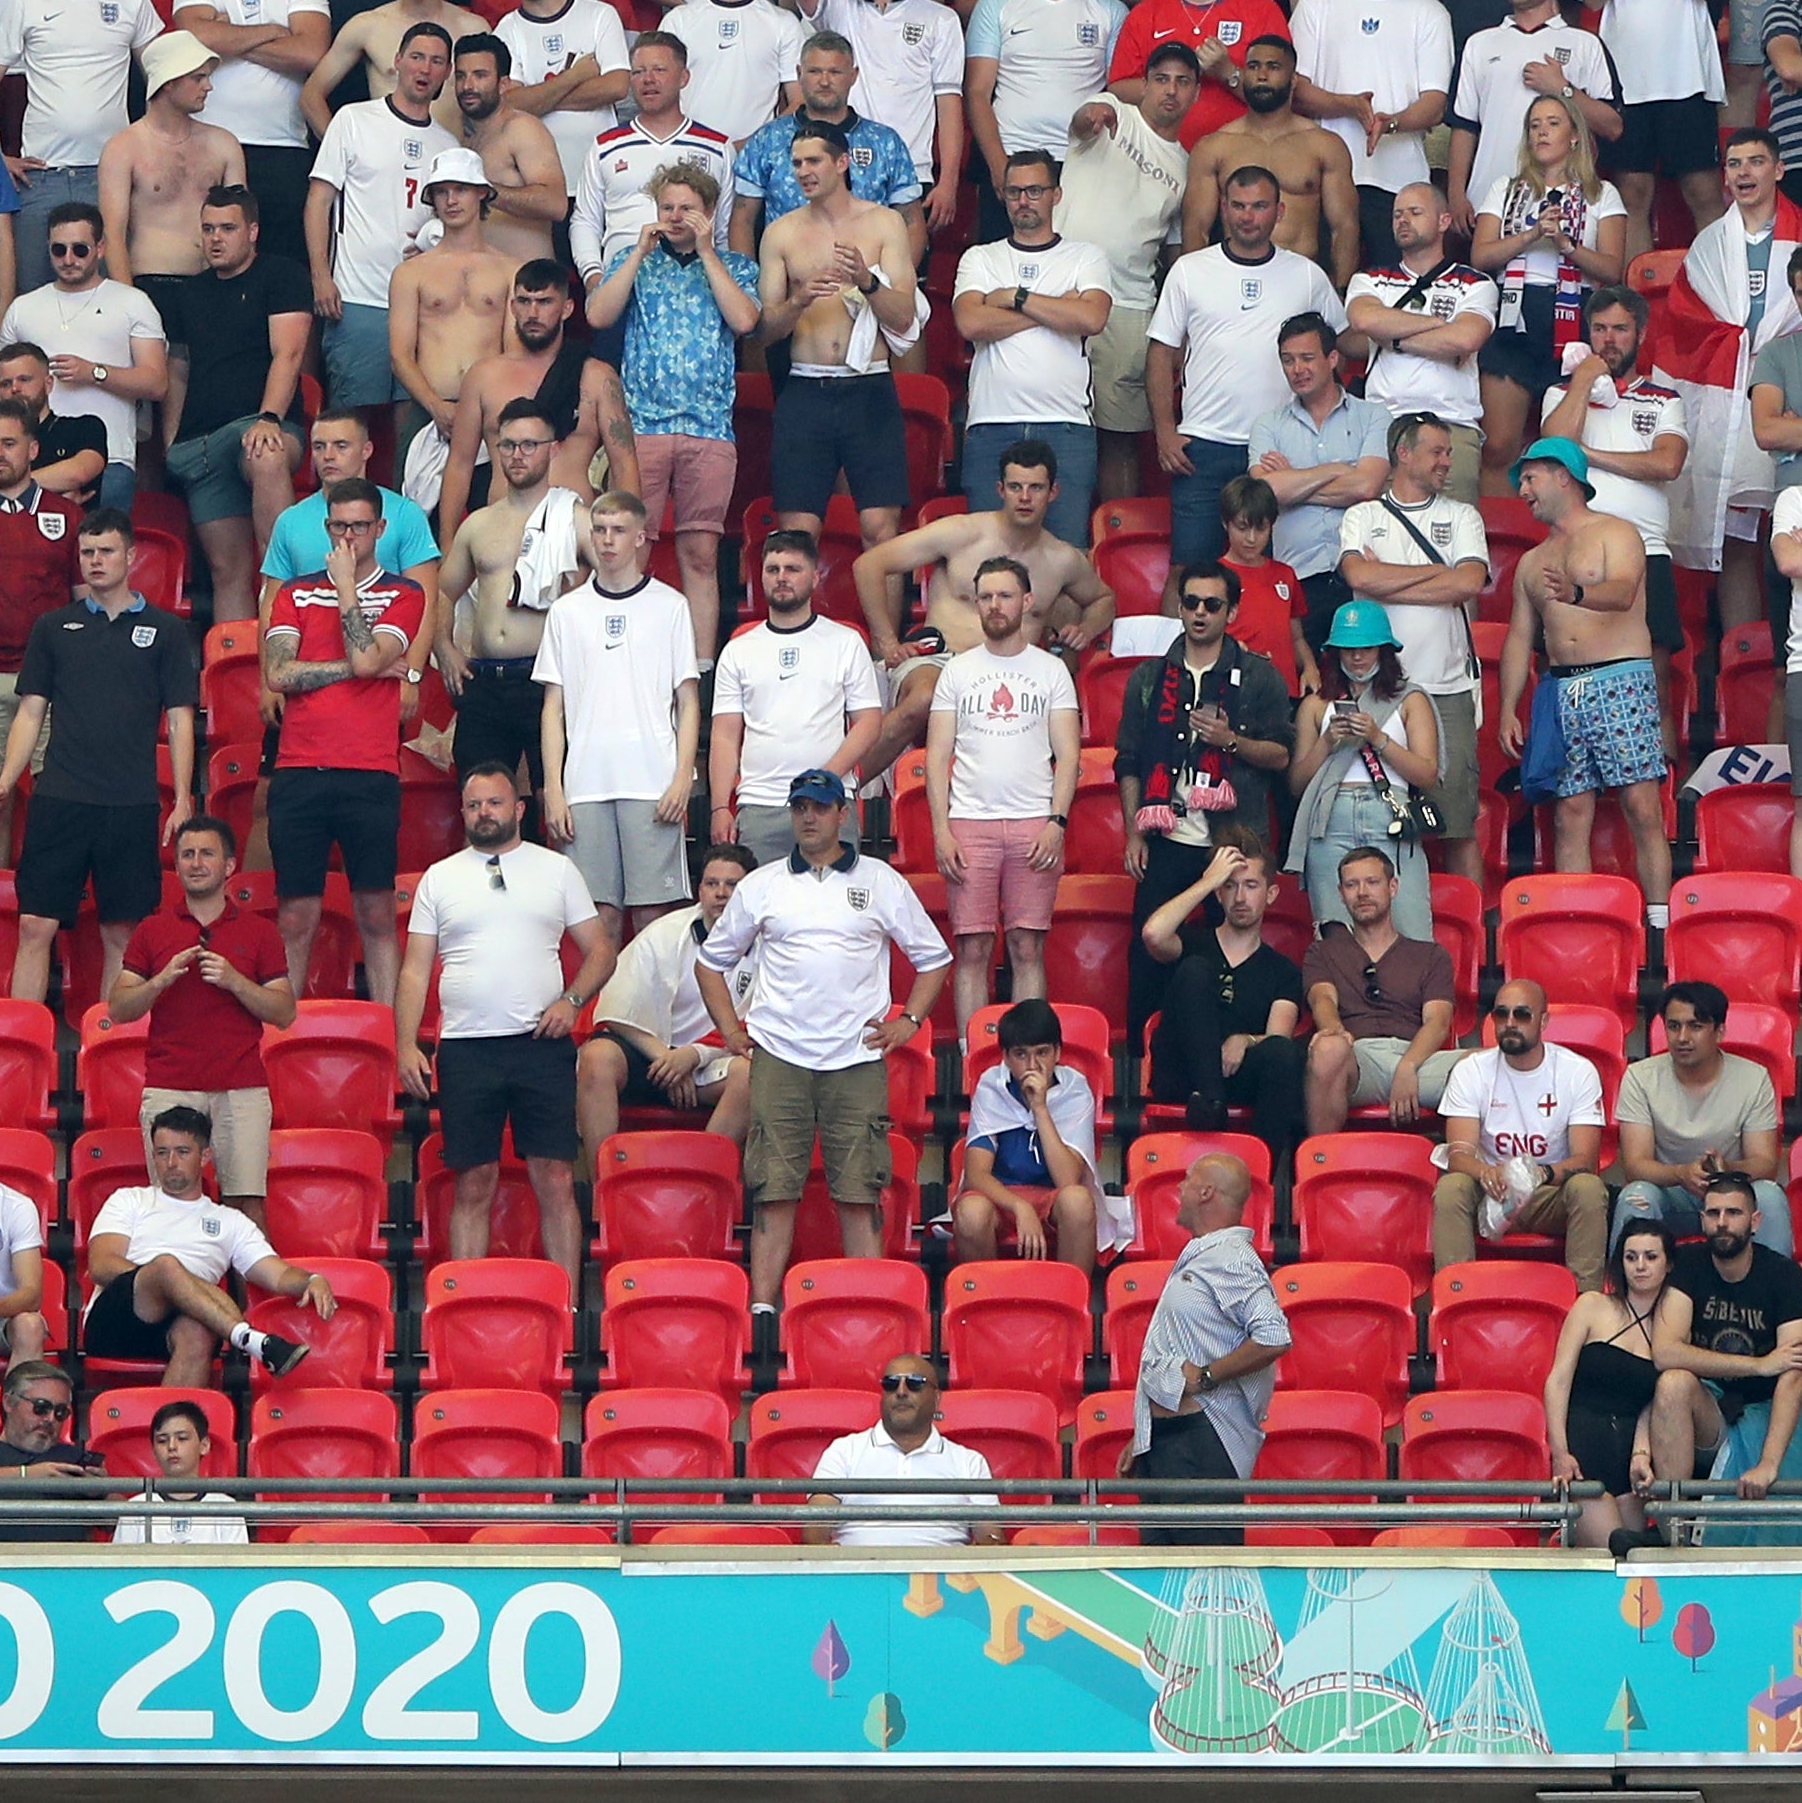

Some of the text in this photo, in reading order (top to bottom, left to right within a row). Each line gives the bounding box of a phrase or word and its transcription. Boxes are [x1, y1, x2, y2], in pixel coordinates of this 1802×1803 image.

[405, 178, 418, 209] 7
[970, 672, 1037, 689] HOLLISTER
[960, 693, 1047, 718] ALL DAY
[1494, 1132, 1548, 1158] ENG
[96, 1581, 622, 1745] 2020
